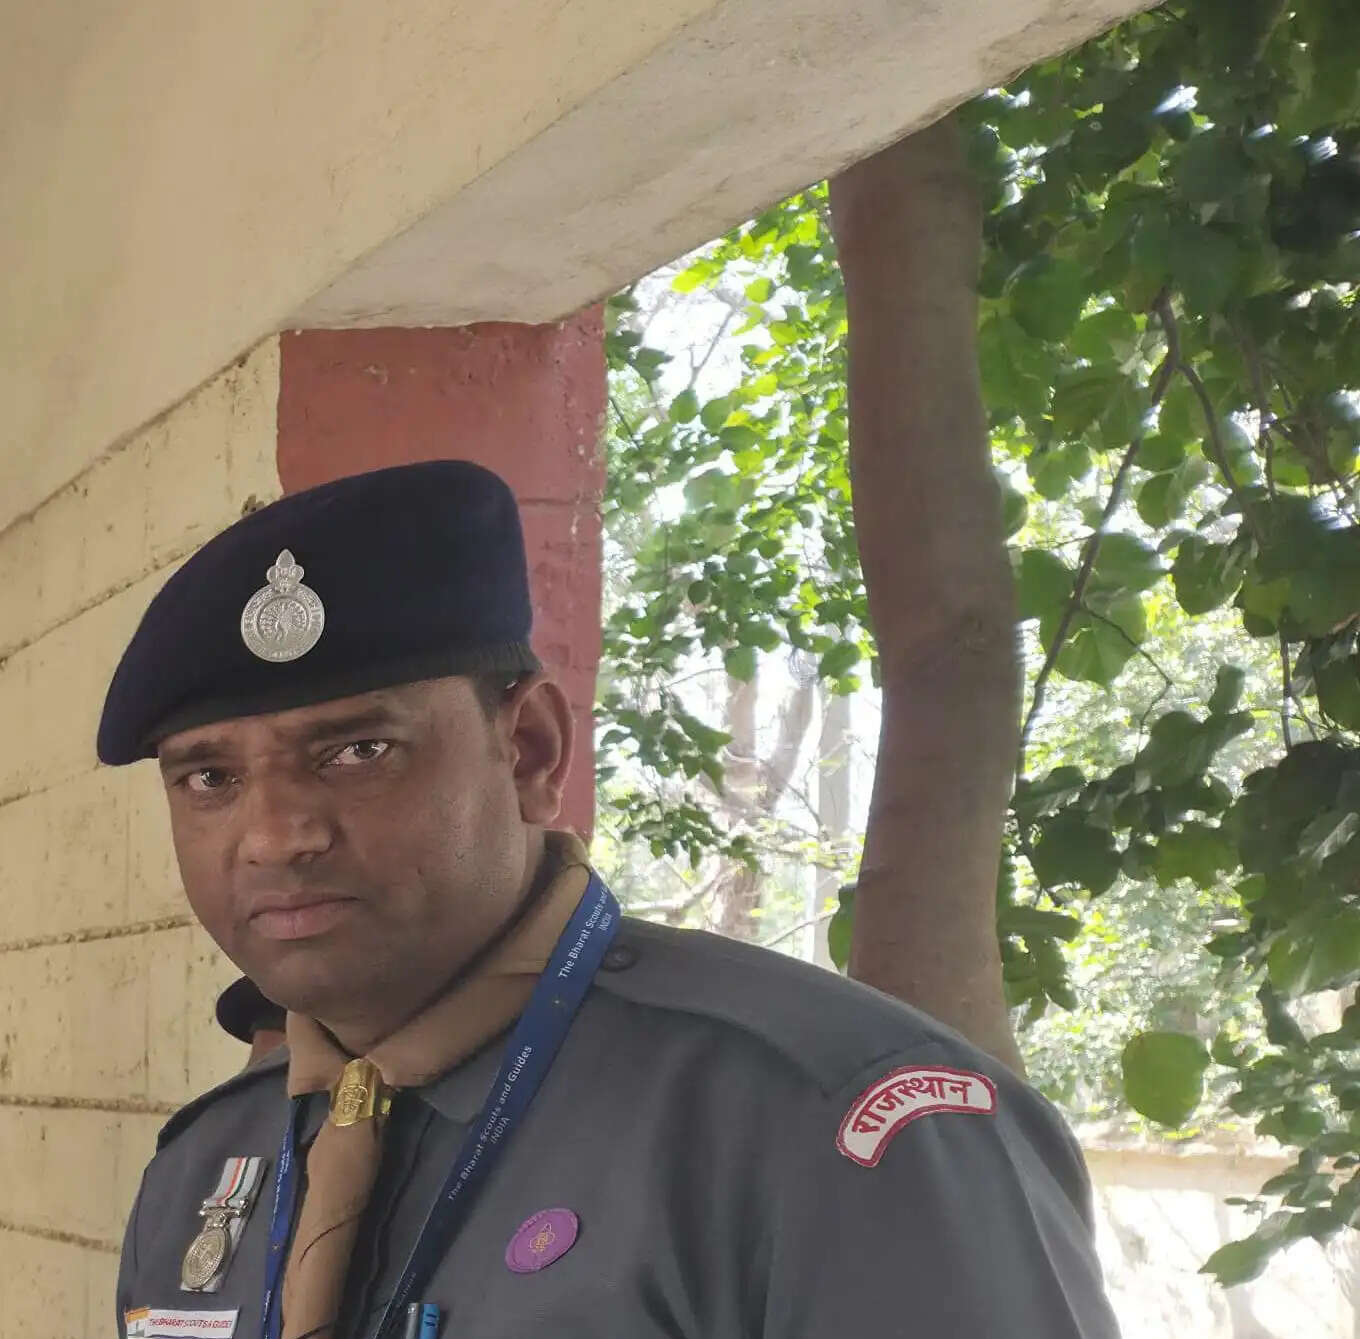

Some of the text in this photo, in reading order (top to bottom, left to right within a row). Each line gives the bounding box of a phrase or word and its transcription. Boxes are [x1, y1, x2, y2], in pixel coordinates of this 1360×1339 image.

[558, 959, 576, 979] The
[568, 929, 592, 960] Bharat
[585, 904, 605, 930] Scouts
[460, 1143, 484, 1181] Bharat
[480, 1106, 503, 1143] Scouts
[499, 1083, 512, 1105] and
[507, 1045, 532, 1082] Guides
[490, 1116, 511, 1144] INDIA
[851, 1076, 972, 1134] राजस्थान
